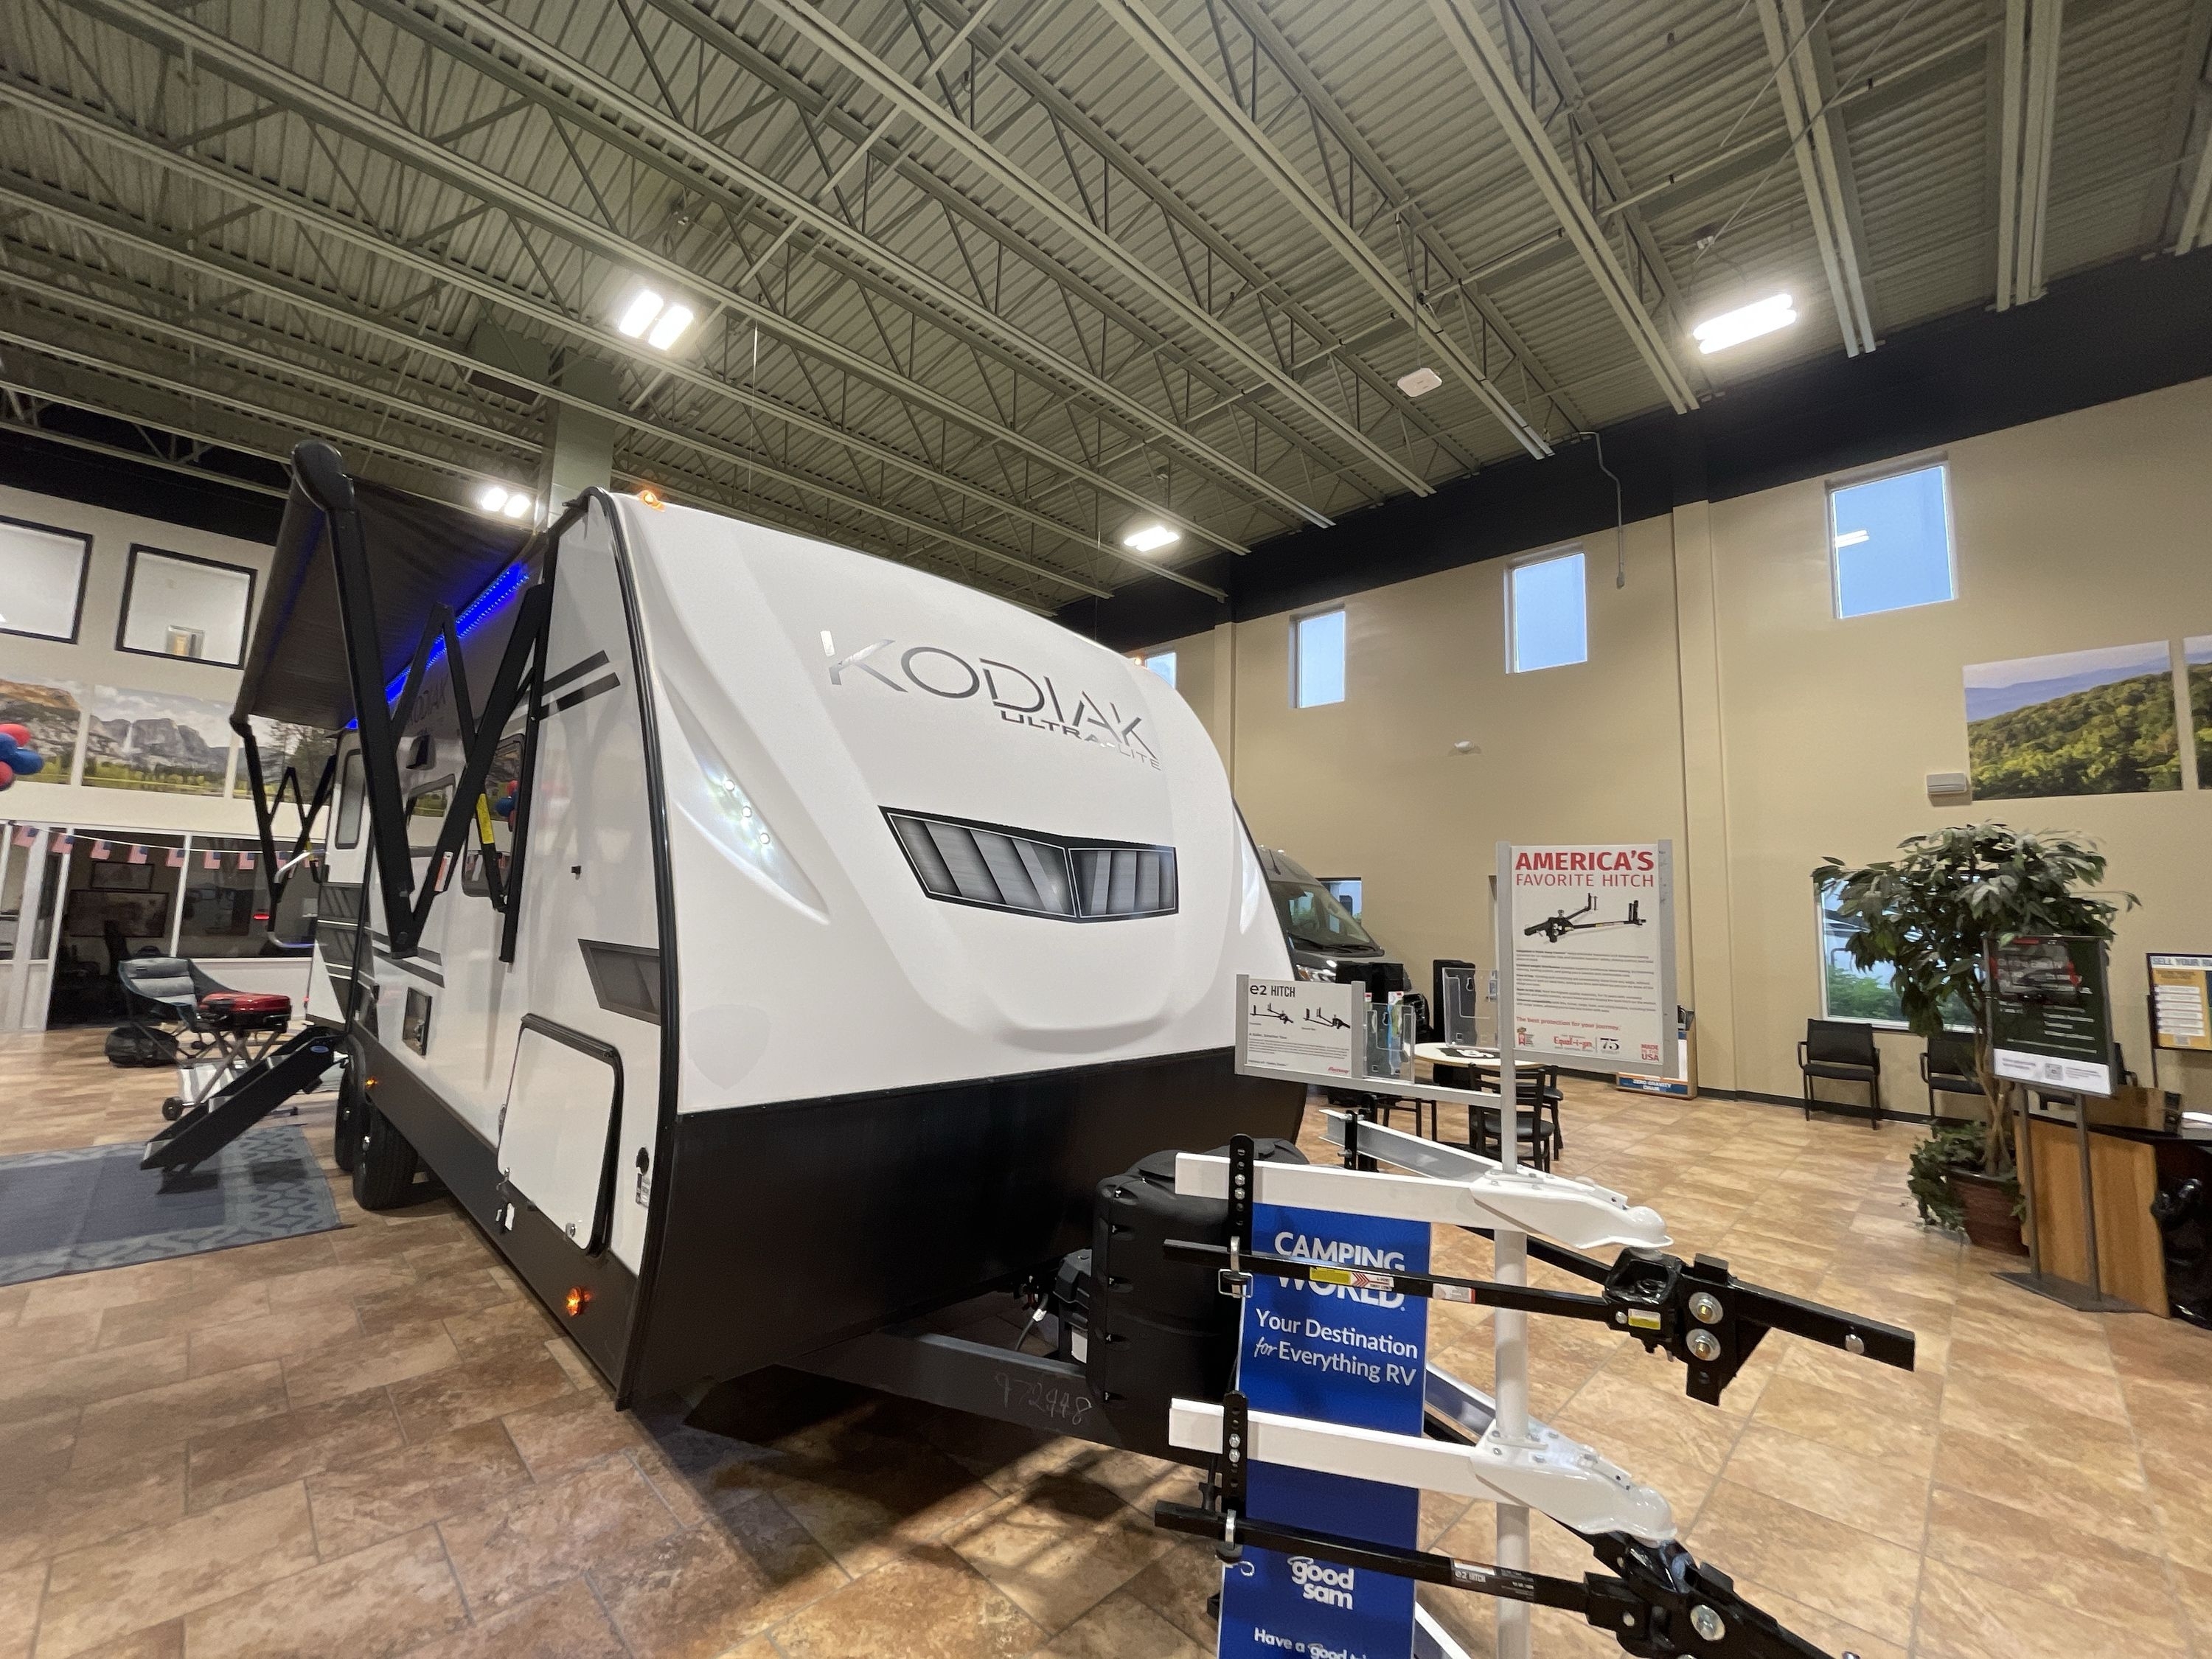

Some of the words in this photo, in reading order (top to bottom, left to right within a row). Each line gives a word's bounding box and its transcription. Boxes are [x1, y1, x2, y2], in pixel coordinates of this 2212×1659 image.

[820, 630, 1158, 760] KODIAK
[1515, 850, 1654, 871] AMERICA'S
[1516, 873, 1594, 887] FAVORITE
[1602, 874, 1654, 888] HITCH
[1250, 984, 1267, 995] e2
[1270, 985, 1295, 998] HITCH
[1600, 1037, 1620, 1051] 75
[1274, 1231, 1406, 1273] CAMPING
[1256, 1307, 1301, 1334] Your
[1306, 1319, 1418, 1359] Destination
[1253, 1336, 1278, 1359] for
[1279, 1342, 1381, 1383] Everything
[1386, 1363, 1416, 1387] RV
[1289, 1557, 1354, 1590] good
[1302, 1582, 1354, 1610] sam
[1254, 1627, 1293, 1649] Have
[1295, 1641, 1305, 1653] a
[1309, 1644, 1347, 1659] good
